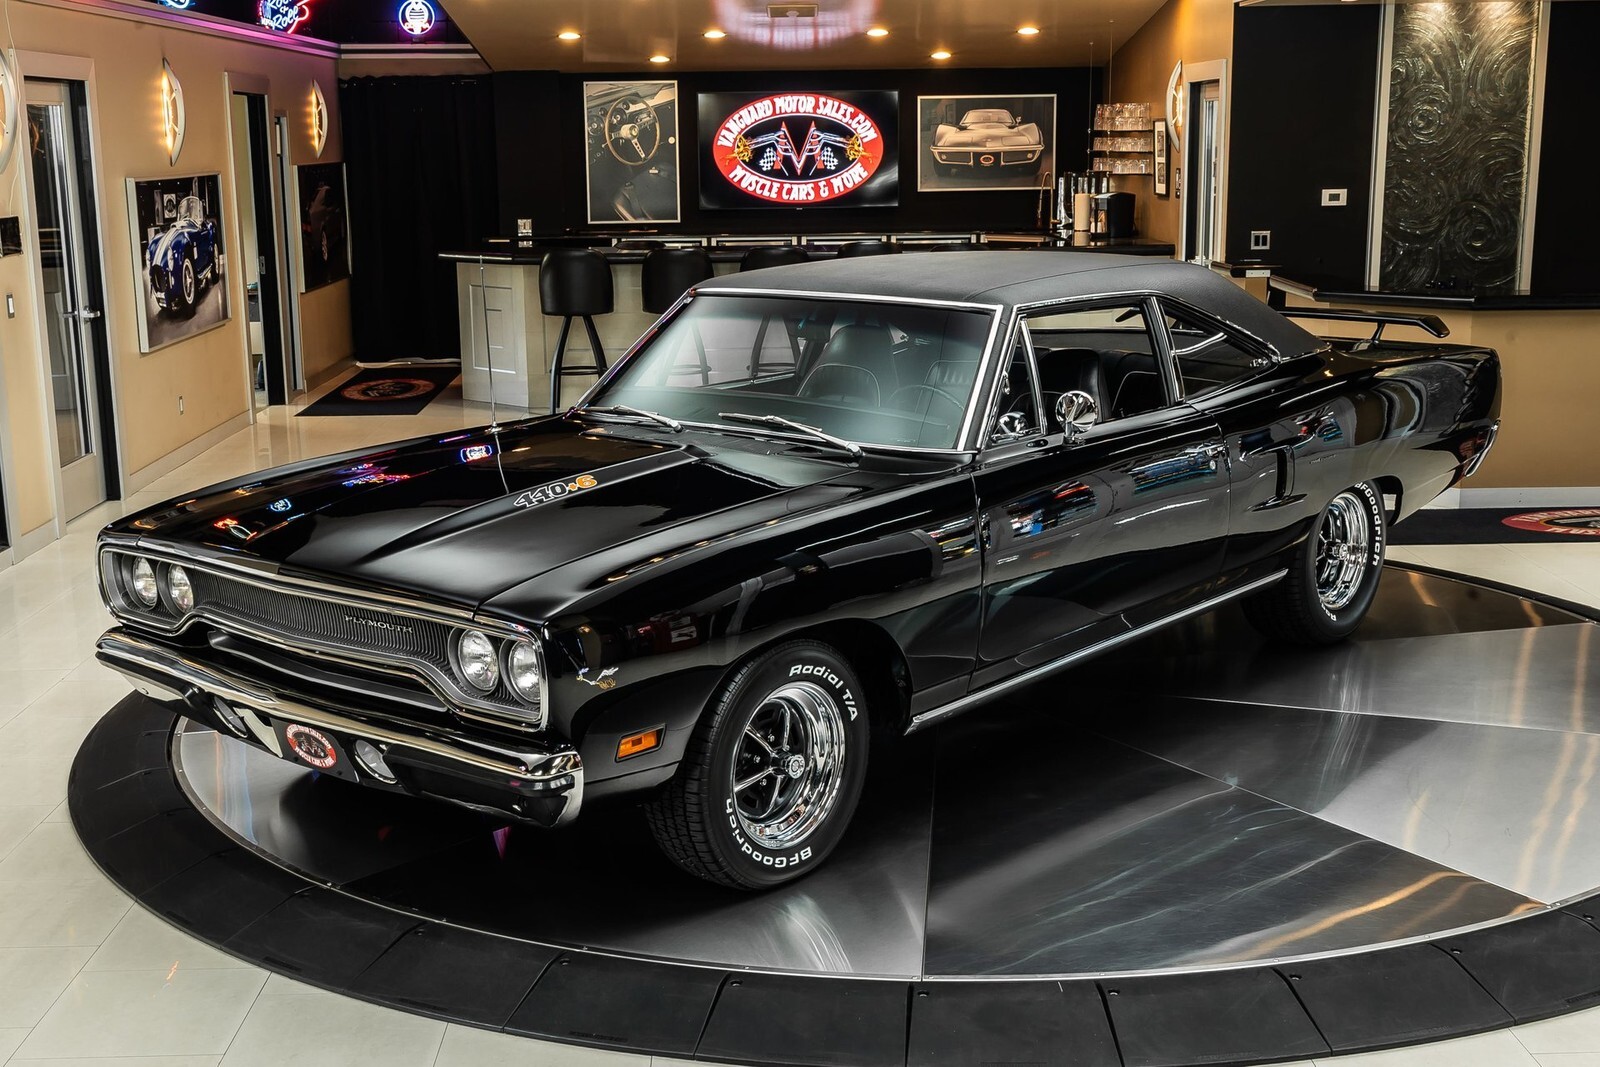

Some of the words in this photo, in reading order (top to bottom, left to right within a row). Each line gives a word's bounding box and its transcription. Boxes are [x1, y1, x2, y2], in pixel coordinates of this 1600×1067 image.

[272, 6, 299, 29] Roll
[717, 99, 774, 148] VANGUARD
[773, 95, 815, 115] MOTOR
[728, 164, 780, 200] MUSCLE
[781, 181, 816, 201] CARS
[819, 181, 830, 198] &
[830, 162, 869, 193] MORE
[345, 614, 413, 634] PLYMOUTH
[788, 664, 844, 689] Radial
[842, 688, 858, 722] T/A
[726, 798, 812, 868] BFGoodrich
